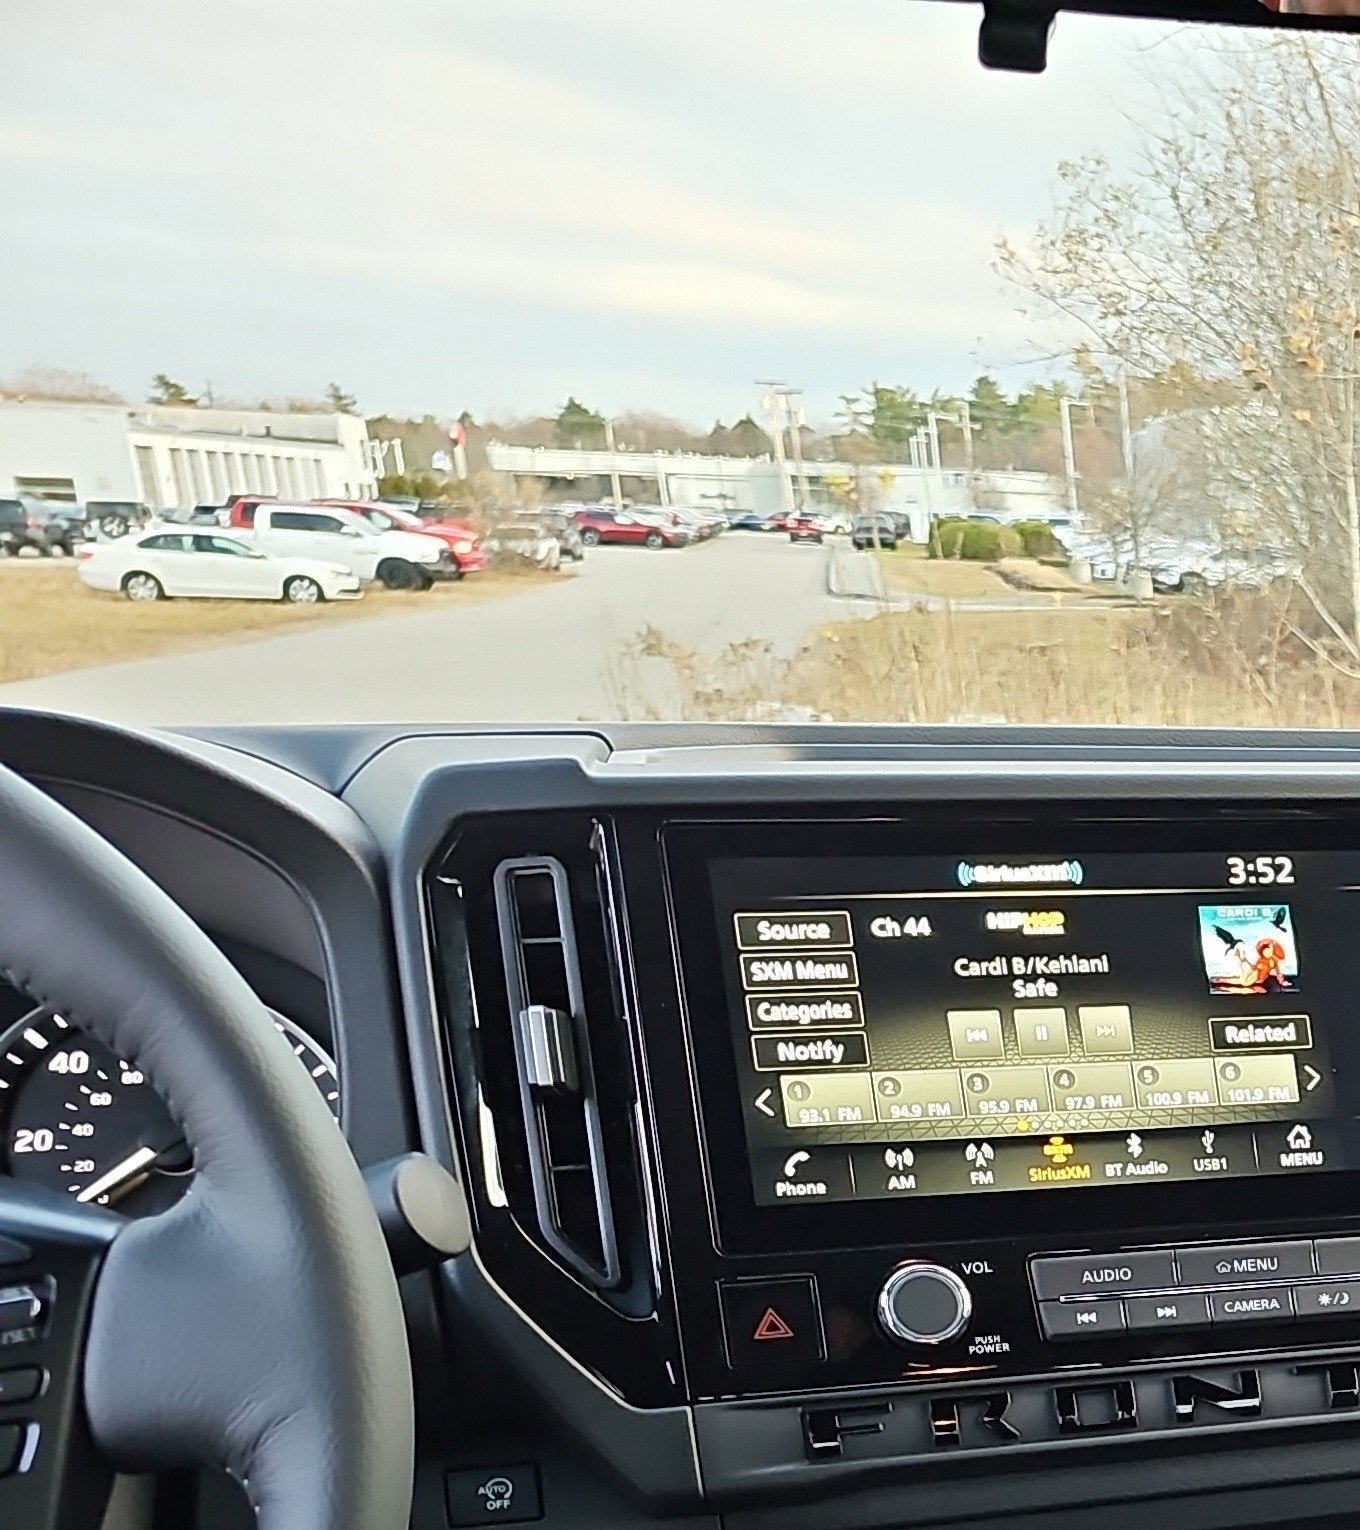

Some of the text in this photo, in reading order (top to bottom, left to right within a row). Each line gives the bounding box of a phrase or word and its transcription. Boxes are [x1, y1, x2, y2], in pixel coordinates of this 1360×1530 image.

[1227, 856, 1295, 885] 3:52
[757, 920, 831, 941] Source
[870, 917, 932, 938] Ch 44
[750, 960, 848, 982] SXM Menu
[953, 954, 1110, 977] Cardi B/Kehlani
[1012, 977, 1058, 998] Safe
[756, 1001, 853, 1023] Categories
[1225, 1023, 1297, 1044] Related
[777, 1041, 845, 1064] Notify
[48, 1050, 90, 1074] 40
[1059, 1073, 1070, 1087] 4
[1143, 1069, 1154, 1083] 5
[1225, 1066, 1235, 1080] 6
[793, 1084, 803, 1098] 1
[885, 1081, 896, 1095] 2
[973, 1077, 983, 1091] 3
[1065, 1094, 1123, 1110] 97.9 FM
[1145, 1091, 1210, 1106] 100.9 FM
[1227, 1087, 1291, 1102] 101.9 FM
[799, 1106, 862, 1123] 93.1 FM
[890, 1102, 951, 1119] 94.9 FM
[979, 1099, 1038, 1115] 95.9 FM
[71, 1124, 94, 1137] 40
[14, 1128, 54, 1152] 20
[73, 1160, 95, 1173] 20
[1192, 1157, 1228, 1172] USB1
[1280, 1152, 1324, 1167] MENU
[1029, 1165, 1091, 1181] SiriusXM
[1105, 1160, 1169, 1177] BT Audio
[887, 1175, 917, 1190] AM
[970, 1170, 995, 1185] FM
[775, 1181, 828, 1197] Phone
[961, 1260, 993, 1275] VOL
[1233, 1256, 1279, 1273] MENU
[1082, 1267, 1132, 1283] AUDIO
[1224, 1297, 1281, 1313] CAMERA
[975, 1334, 1001, 1345] PUSH
[968, 1341, 1010, 1355] POWER
[486, 1499, 511, 1511] OFF
